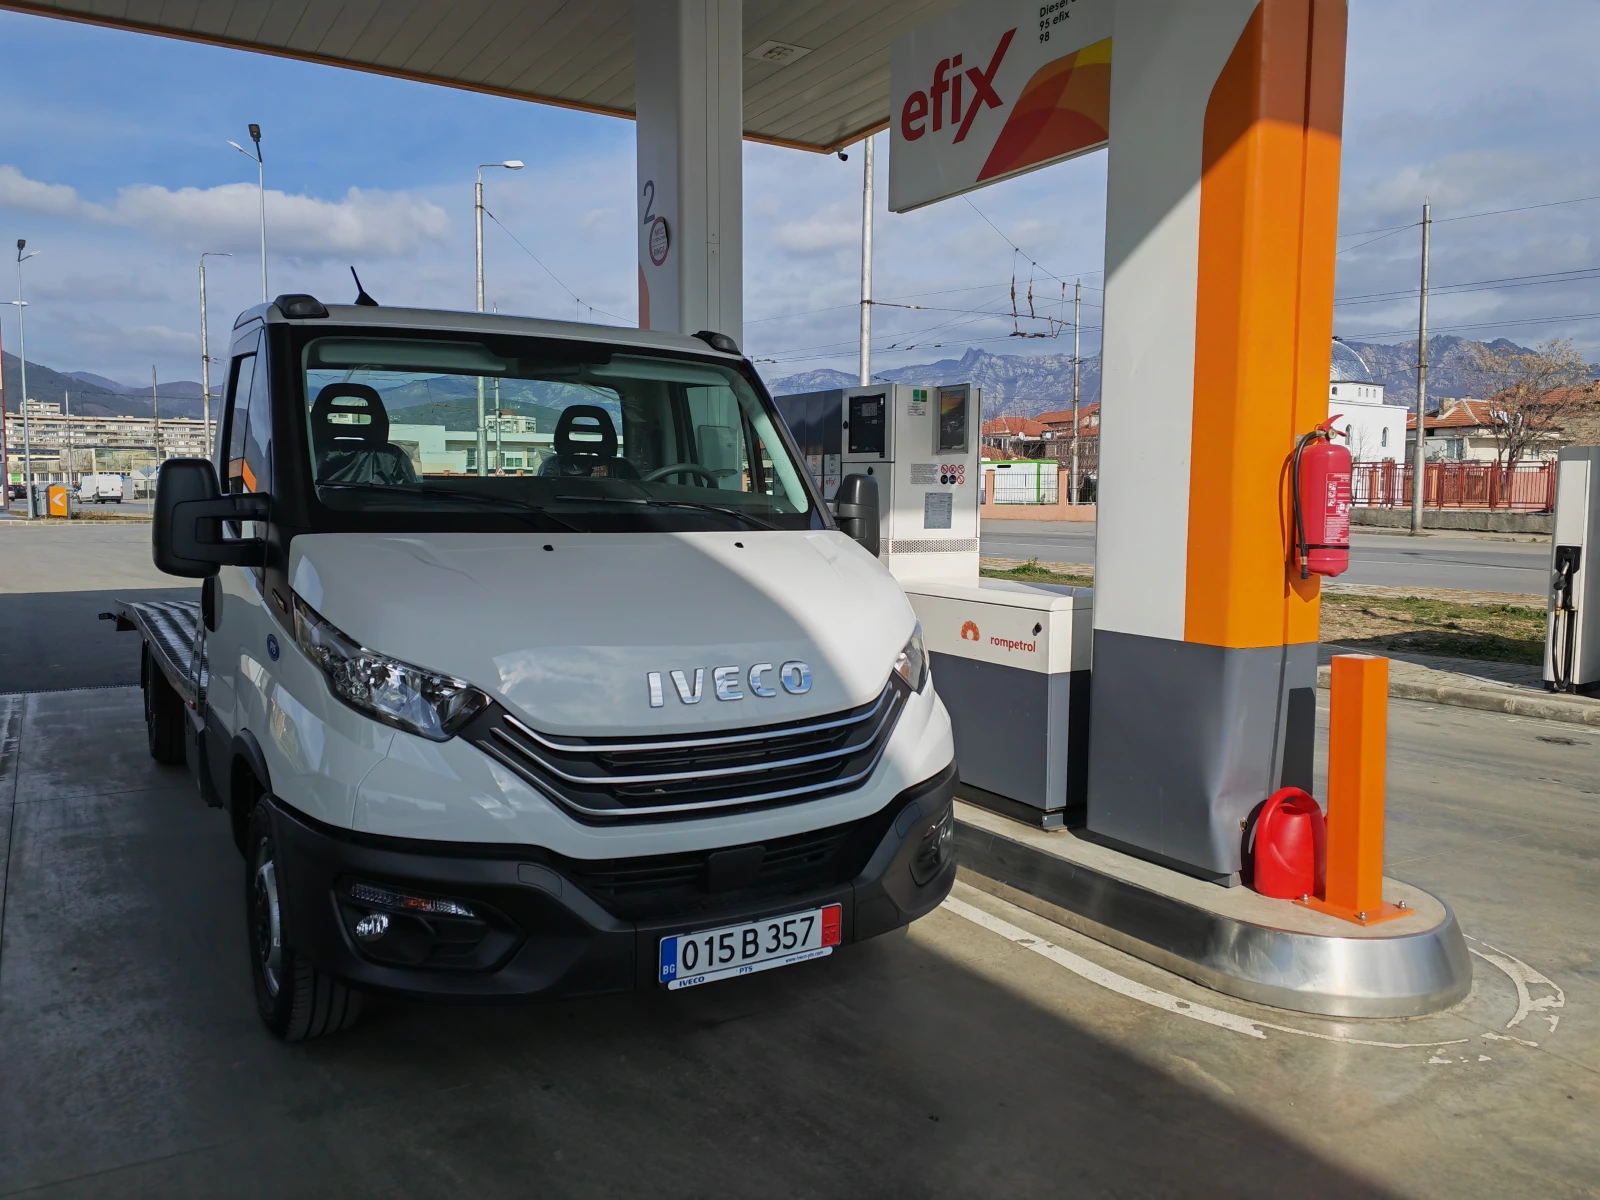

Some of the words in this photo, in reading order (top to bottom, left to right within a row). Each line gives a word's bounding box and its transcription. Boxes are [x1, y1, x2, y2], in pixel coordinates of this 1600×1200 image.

[1039, 18, 1050, 31] 95
[1053, 10, 1070, 25] efix
[1039, 31, 1050, 44] 98
[901, 27, 1017, 144] efix
[643, 179, 656, 225] 2
[990, 636, 1036, 652] rompetrol
[647, 660, 813, 708] IVECO
[662, 963, 676, 976] BG
[679, 976, 705, 987] IVECO
[739, 965, 753, 975] PTS
